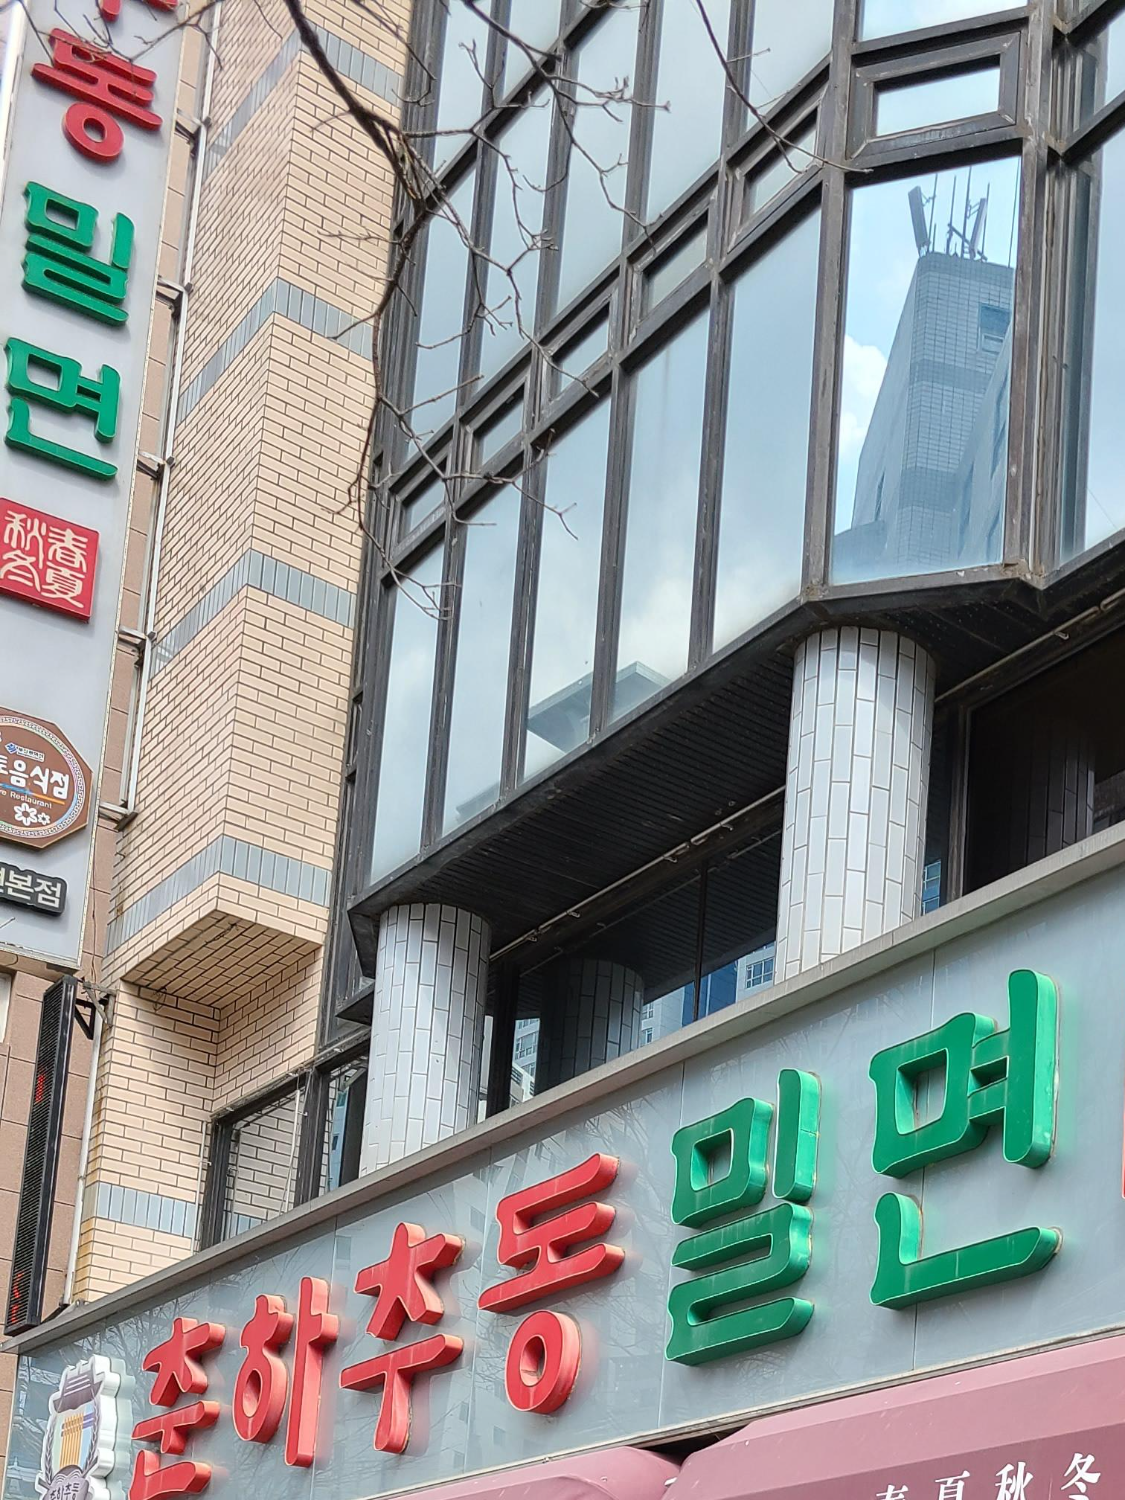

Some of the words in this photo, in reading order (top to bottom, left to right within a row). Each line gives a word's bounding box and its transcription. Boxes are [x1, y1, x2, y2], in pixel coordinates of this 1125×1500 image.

[4, 180, 136, 481] 밀면
[10, 791, 52, 809] Restaurant
[665, 968, 1064, 1367] 밀면
